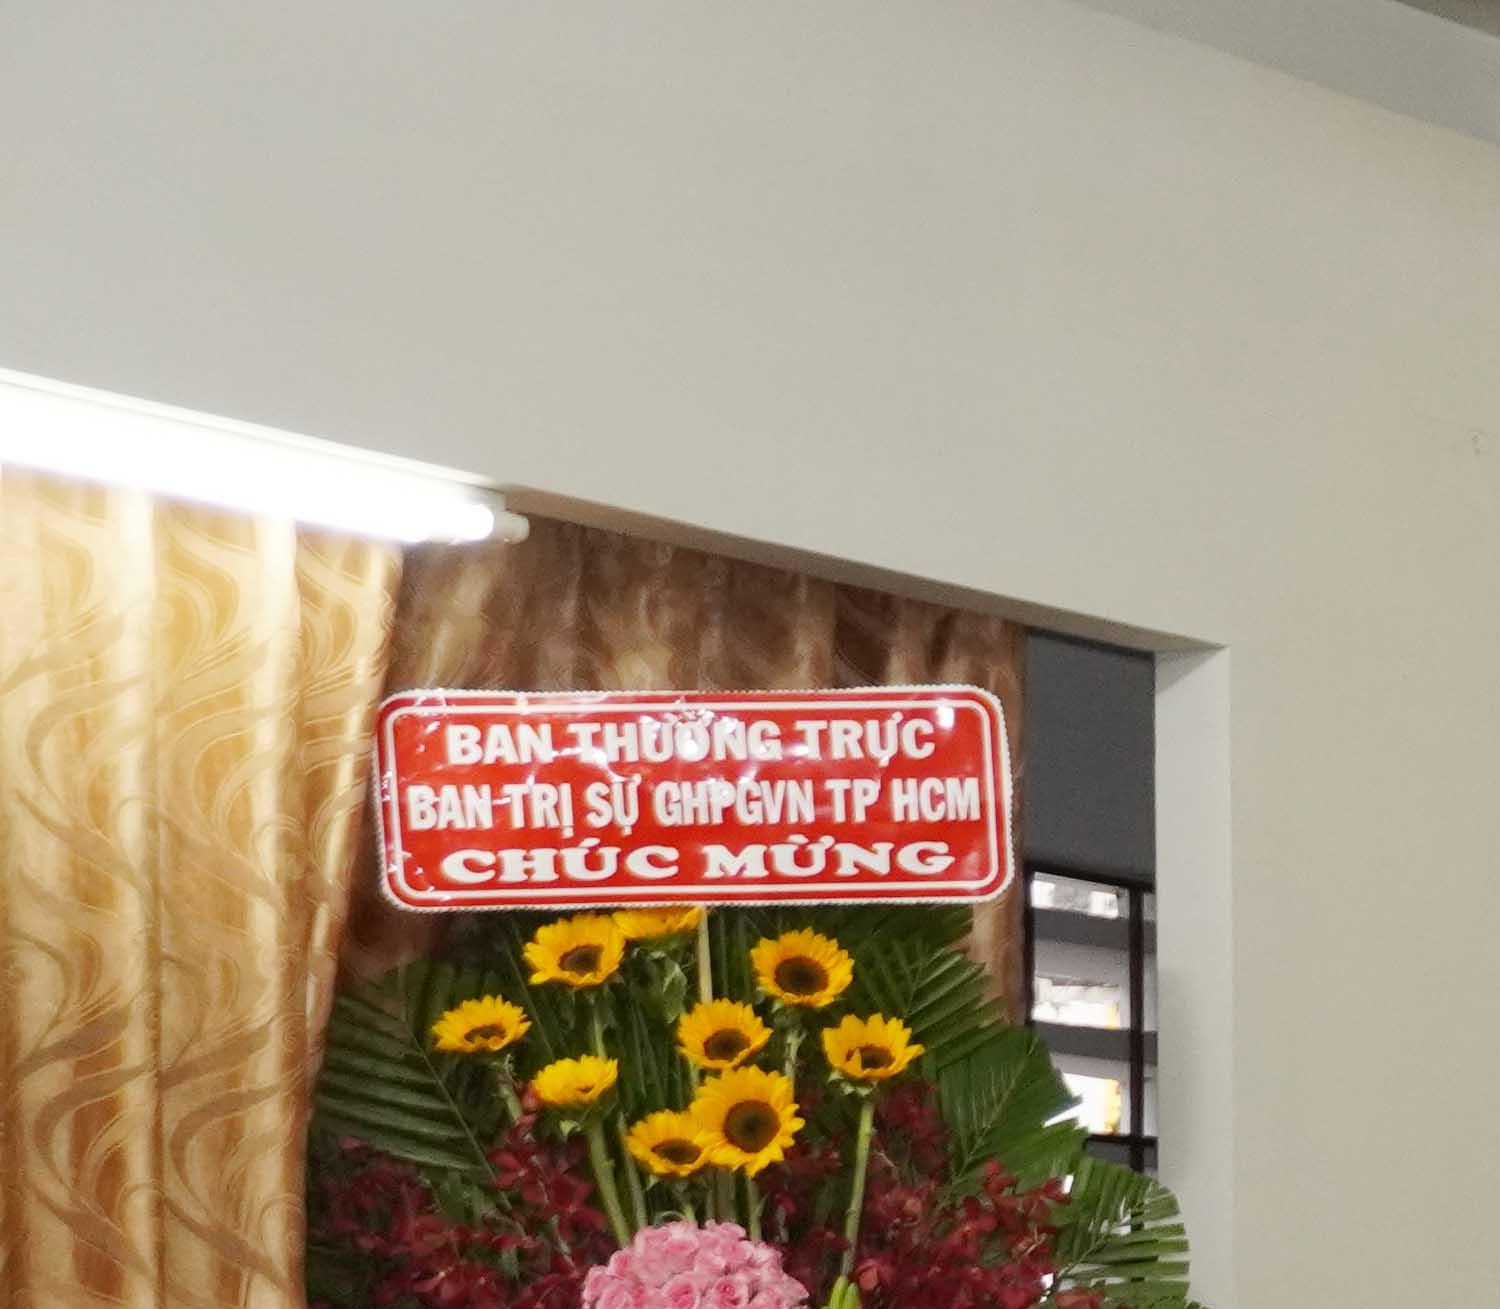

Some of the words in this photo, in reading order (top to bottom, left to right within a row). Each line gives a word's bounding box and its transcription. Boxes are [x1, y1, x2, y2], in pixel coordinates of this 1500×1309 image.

[447, 722, 555, 766] BAN
[793, 714, 938, 767] TRỰC
[408, 782, 493, 832] BAN
[503, 780, 572, 838] TRỊ
[586, 774, 642, 836] SỰ
[655, 777, 815, 826] GHPGVN
[826, 777, 880, 825] TP
[892, 776, 982, 823] HCM
[439, 838, 680, 885] CHÚC
[704, 832, 956, 881] MỪNG
